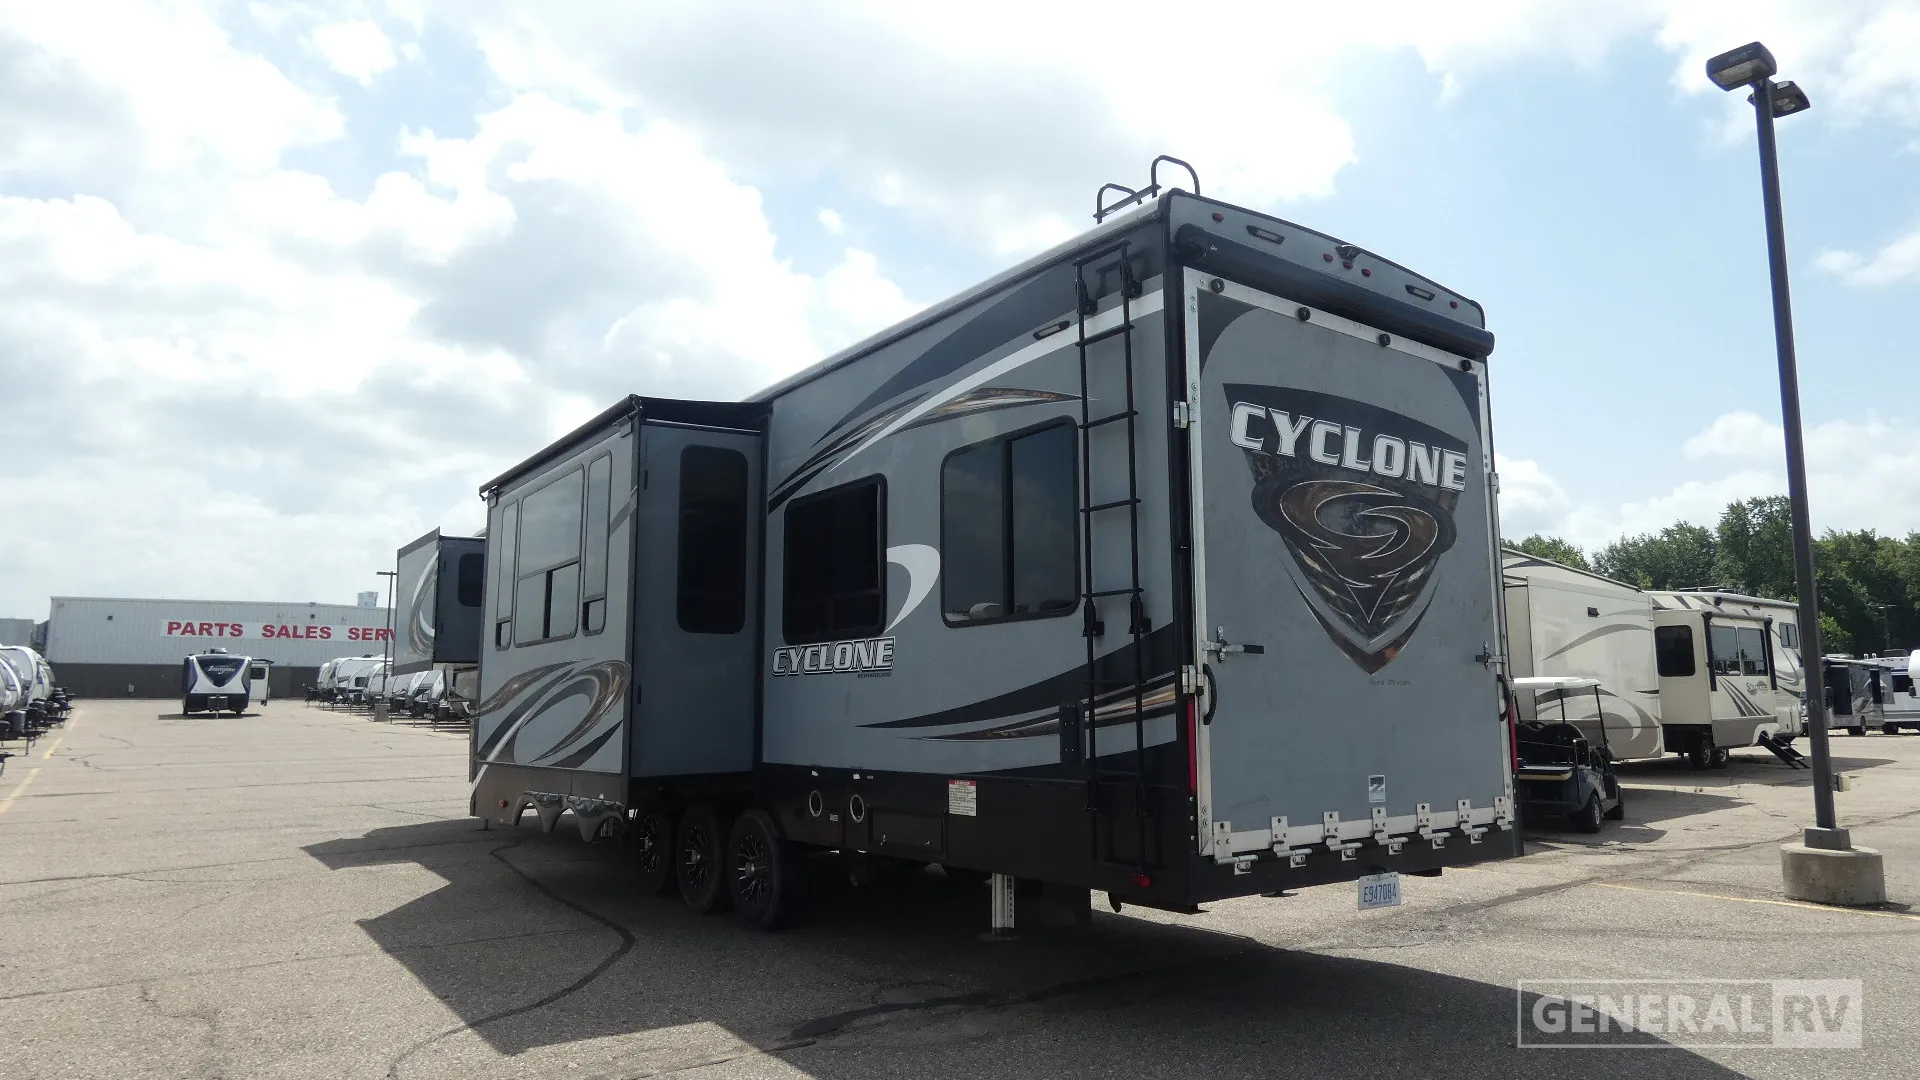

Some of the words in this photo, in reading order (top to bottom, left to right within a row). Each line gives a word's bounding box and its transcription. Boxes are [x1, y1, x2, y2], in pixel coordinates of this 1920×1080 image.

[1229, 401, 1467, 492] CYCLONE
[167, 621, 244, 637] PARTS
[262, 624, 332, 640] SALES
[772, 636, 896, 677] CYCLONE
